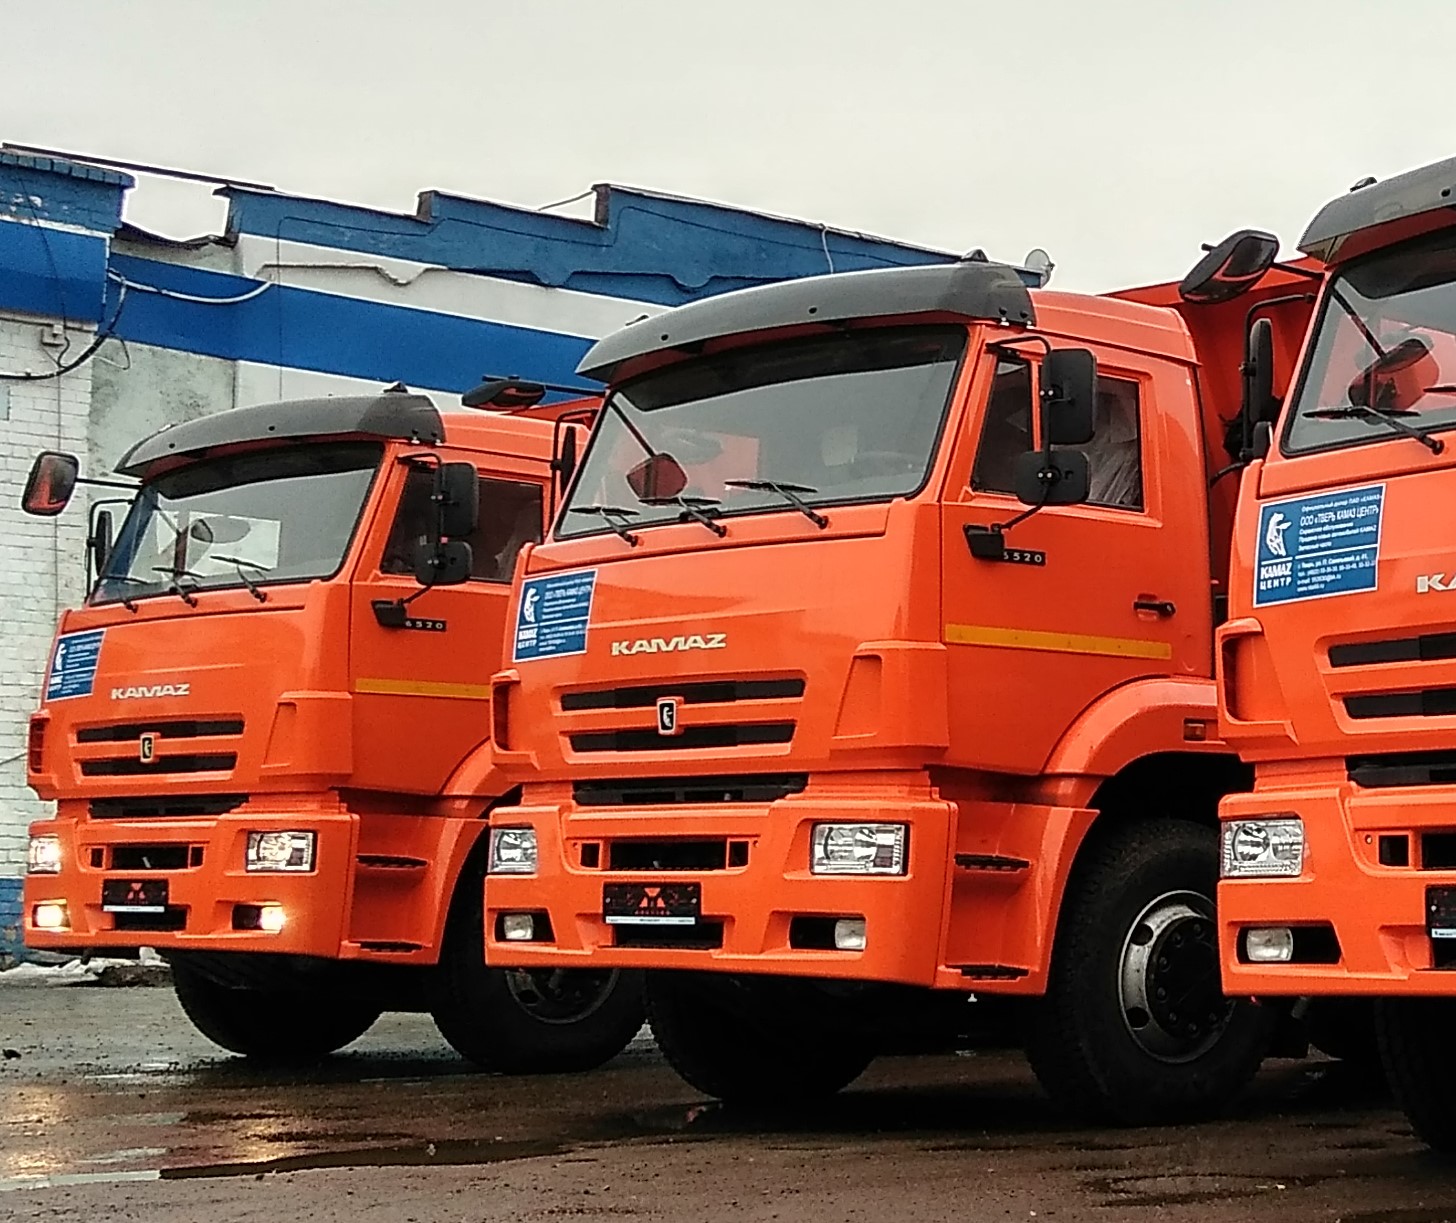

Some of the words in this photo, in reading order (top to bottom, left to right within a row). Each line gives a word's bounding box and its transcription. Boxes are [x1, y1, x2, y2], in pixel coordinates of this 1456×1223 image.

[1260, 576, 1292, 590] ЦЕНТР
[611, 633, 727, 656] KAMAZ
[111, 683, 190, 699] KAMAZ
